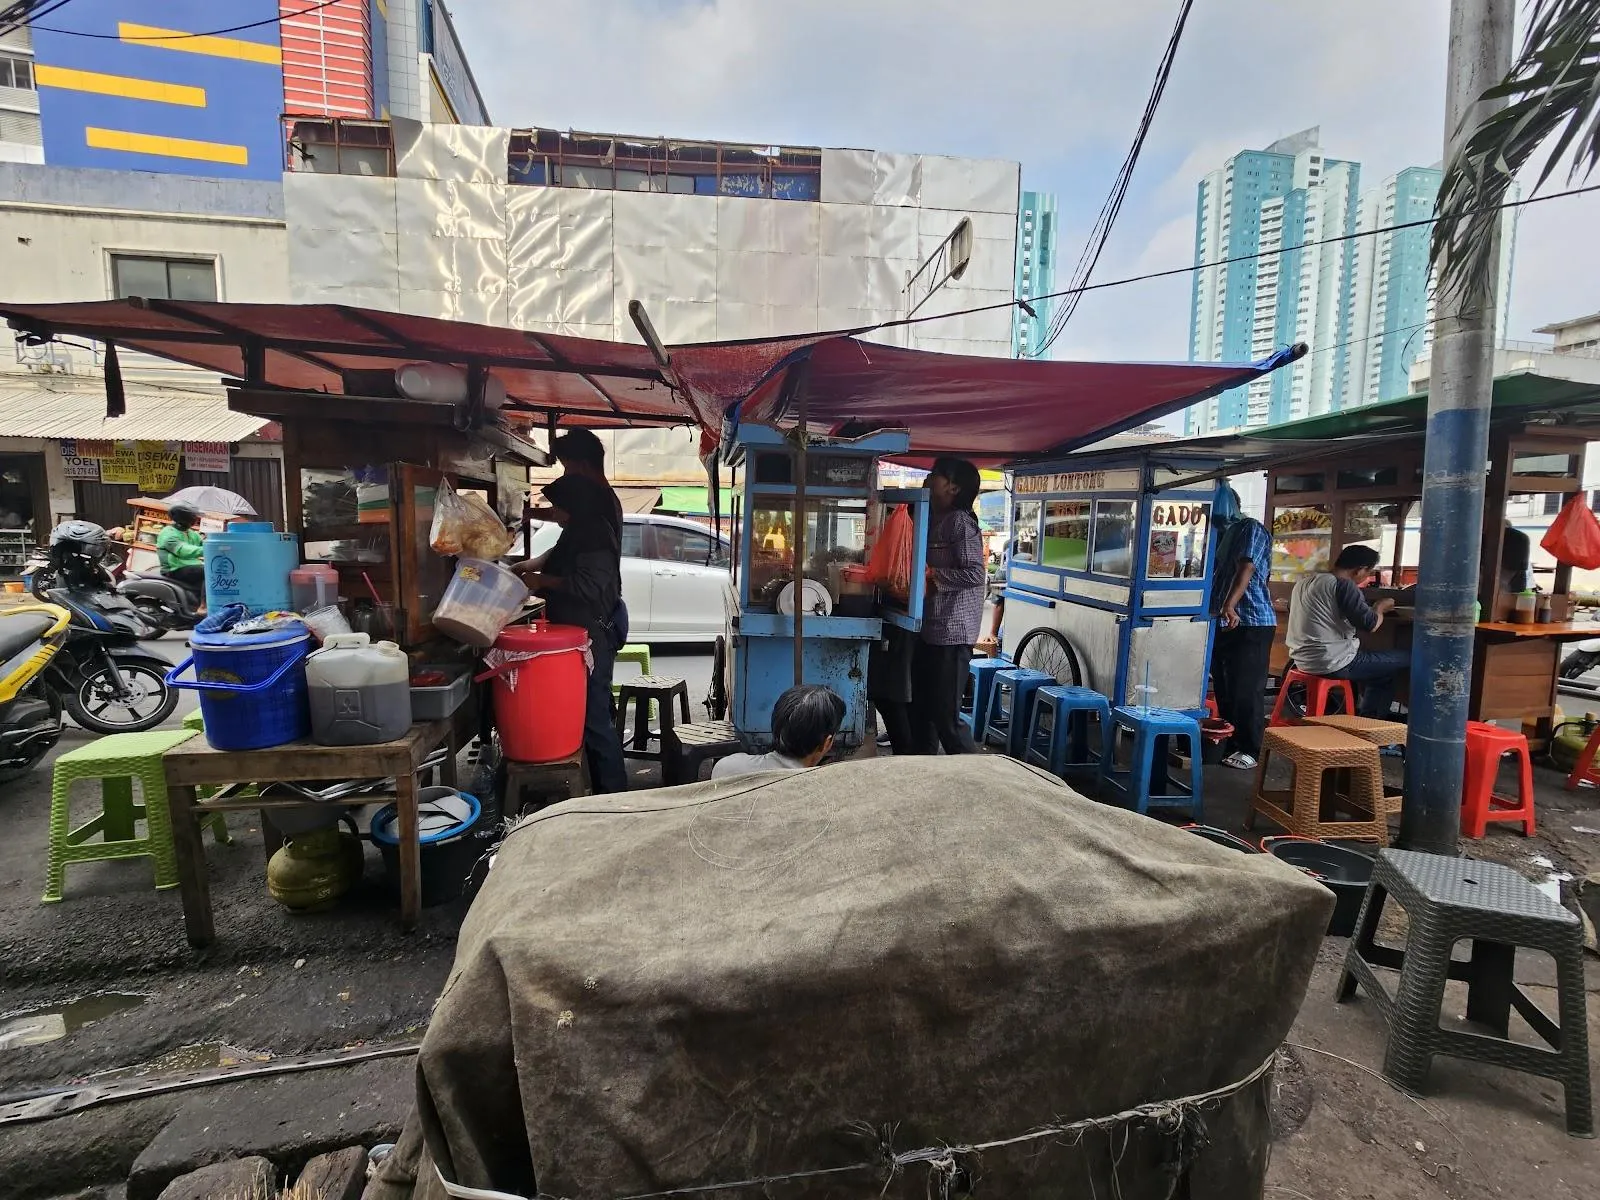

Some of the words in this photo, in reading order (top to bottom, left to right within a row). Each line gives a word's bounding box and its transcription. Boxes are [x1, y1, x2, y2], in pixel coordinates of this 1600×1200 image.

[61, 447, 77, 456] DIS
[138, 451, 179, 462] DISEWA
[65, 457, 95, 466] YOEL
[1053, 472, 1106, 491] LONTONG
[1153, 505, 1202, 526] GADO
